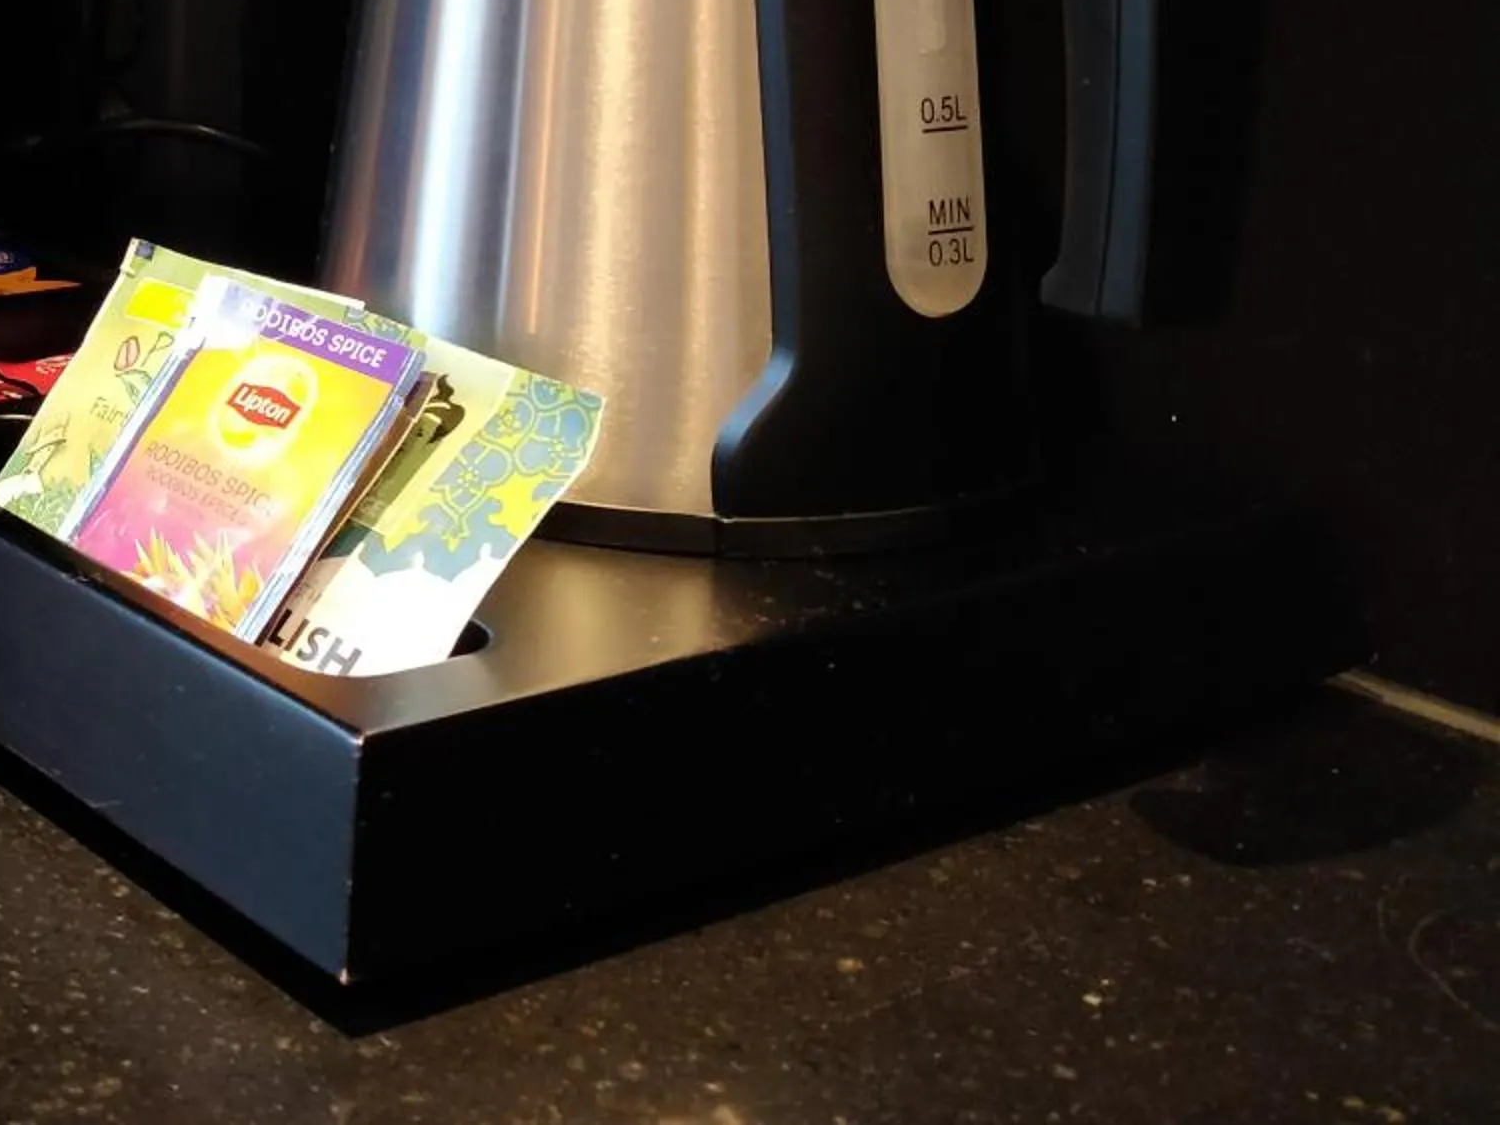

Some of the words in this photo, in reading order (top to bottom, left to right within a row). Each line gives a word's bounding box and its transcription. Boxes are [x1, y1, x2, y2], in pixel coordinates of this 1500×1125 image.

[920, 94, 967, 124] 0.5L
[928, 195, 972, 226] MIN
[928, 237, 974, 268] 0.3L
[327, 333, 388, 368] SPICE
[233, 386, 292, 424] Lipton
[145, 440, 223, 487] ROOIBOS
[221, 476, 274, 518] SPIC
[262, 608, 362, 675] LISH
